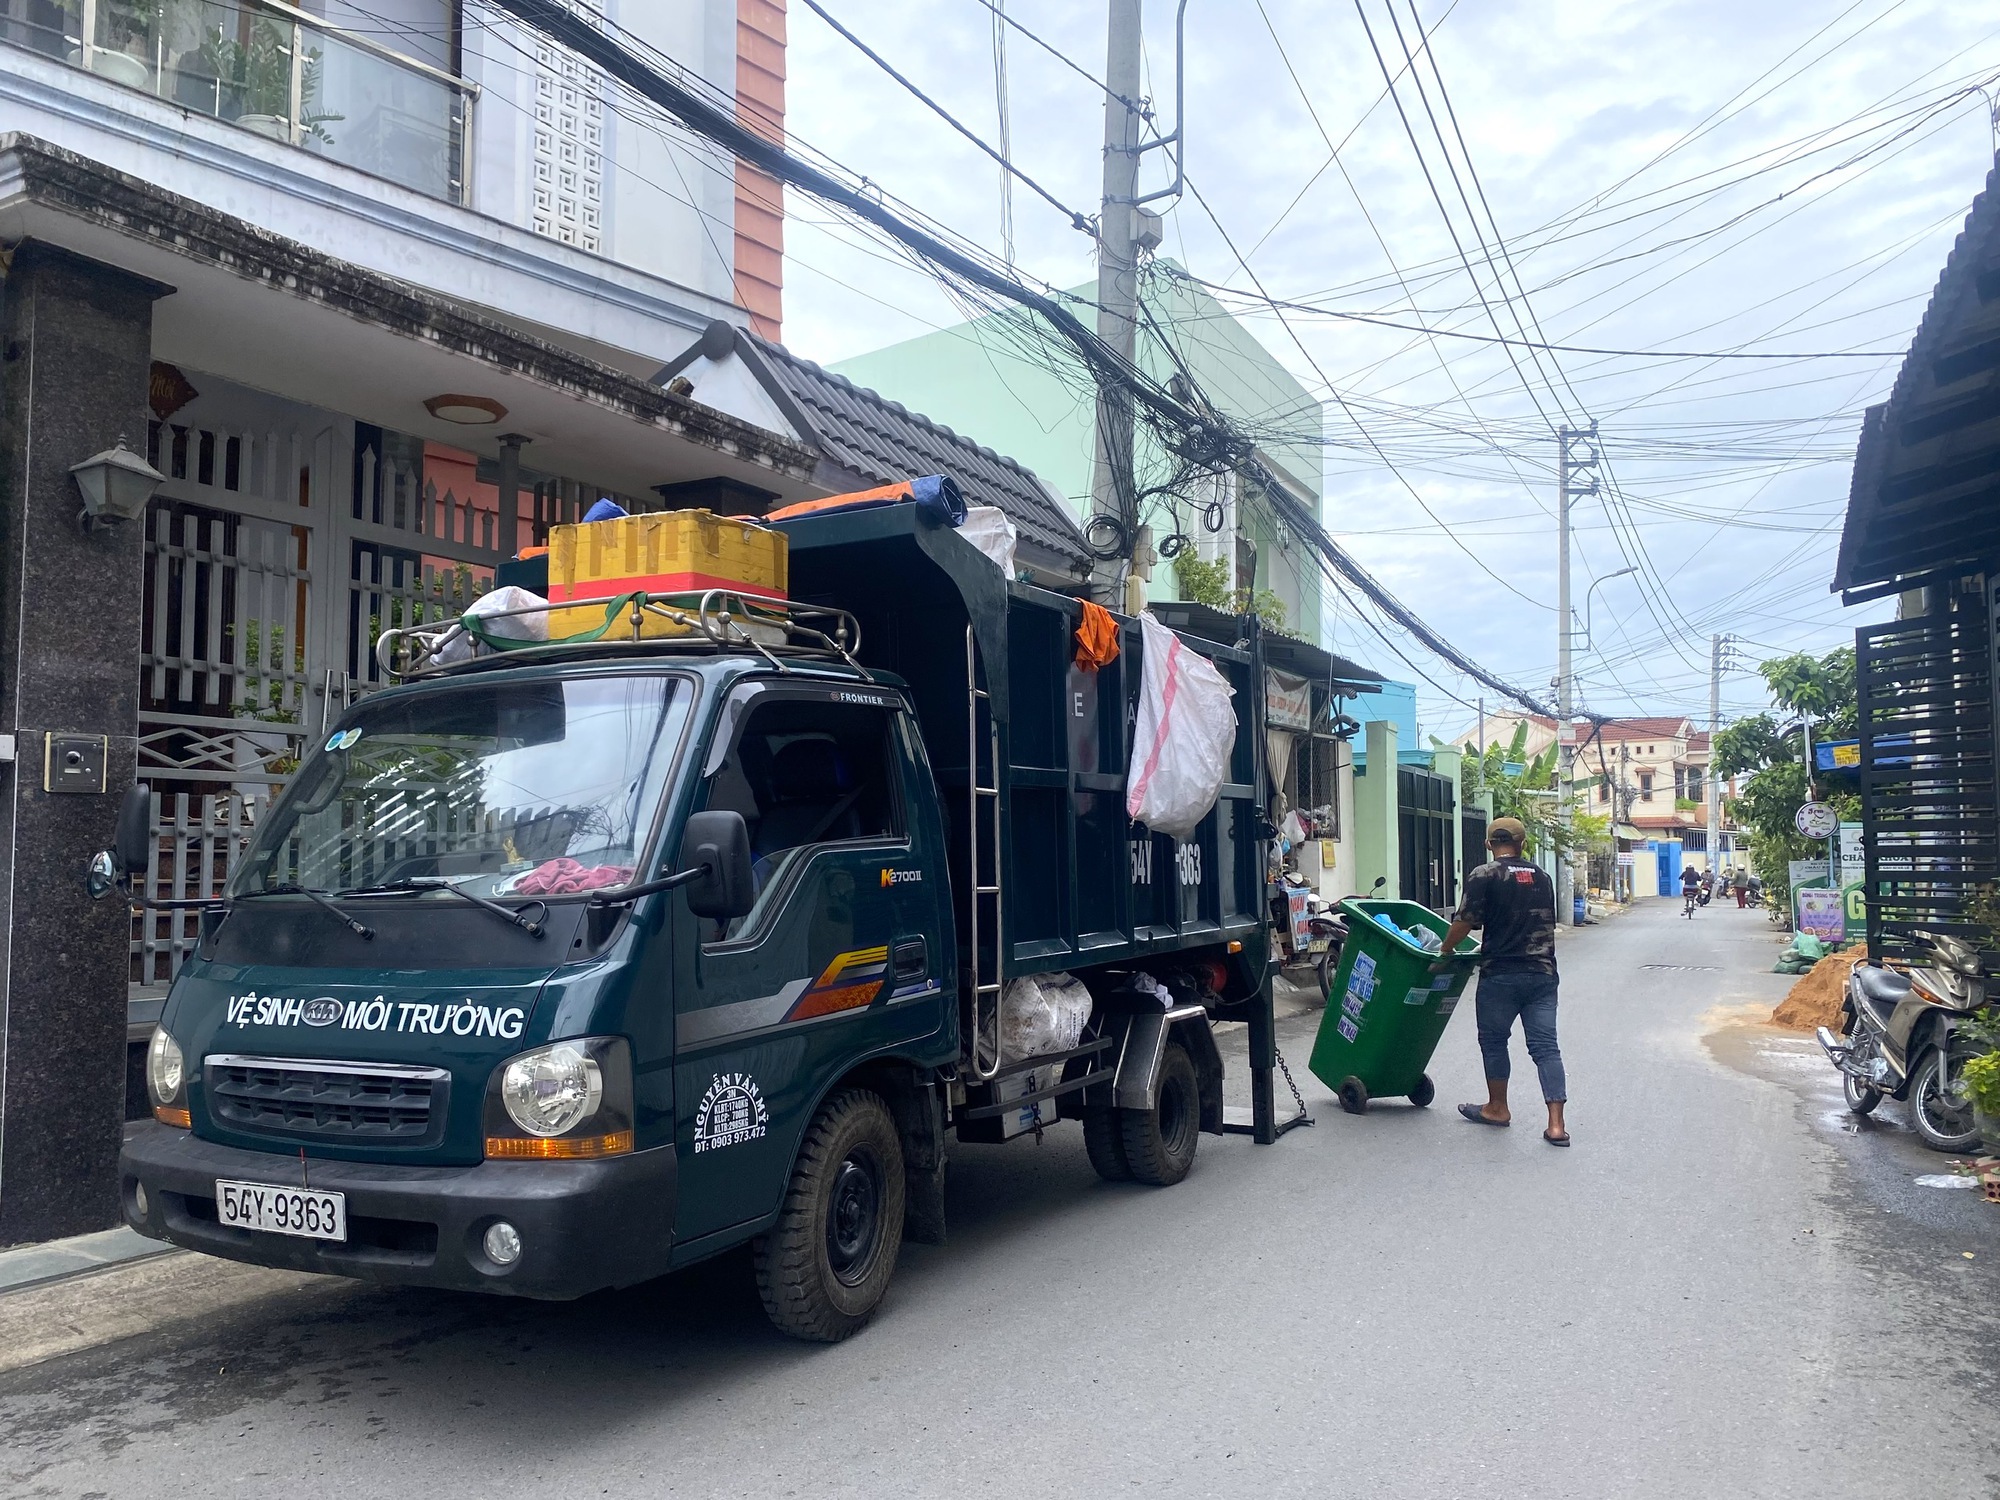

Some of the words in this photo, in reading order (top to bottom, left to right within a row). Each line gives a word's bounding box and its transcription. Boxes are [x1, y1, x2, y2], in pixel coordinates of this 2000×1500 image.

[840, 692, 883, 705] FRONTIER
[1074, 692, 1084, 717] E
[1131, 840, 1152, 885] 54Y
[227, 991, 257, 1029] VỆ
[253, 996, 305, 1027] SINH
[341, 995, 393, 1031] MÔI
[397, 998, 524, 1039] TRƯỜNG
[305, 1003, 336, 1021] KIA
[694, 1073, 730, 1140] NGUYỄN
[734, 1073, 759, 1097] VĂN
[695, 1140, 709, 1154] ĐT:
[711, 1134, 732, 1150] 0903
[734, 1126, 766, 1144] 973.472
[224, 1186, 336, 1234] 54Y-9363
